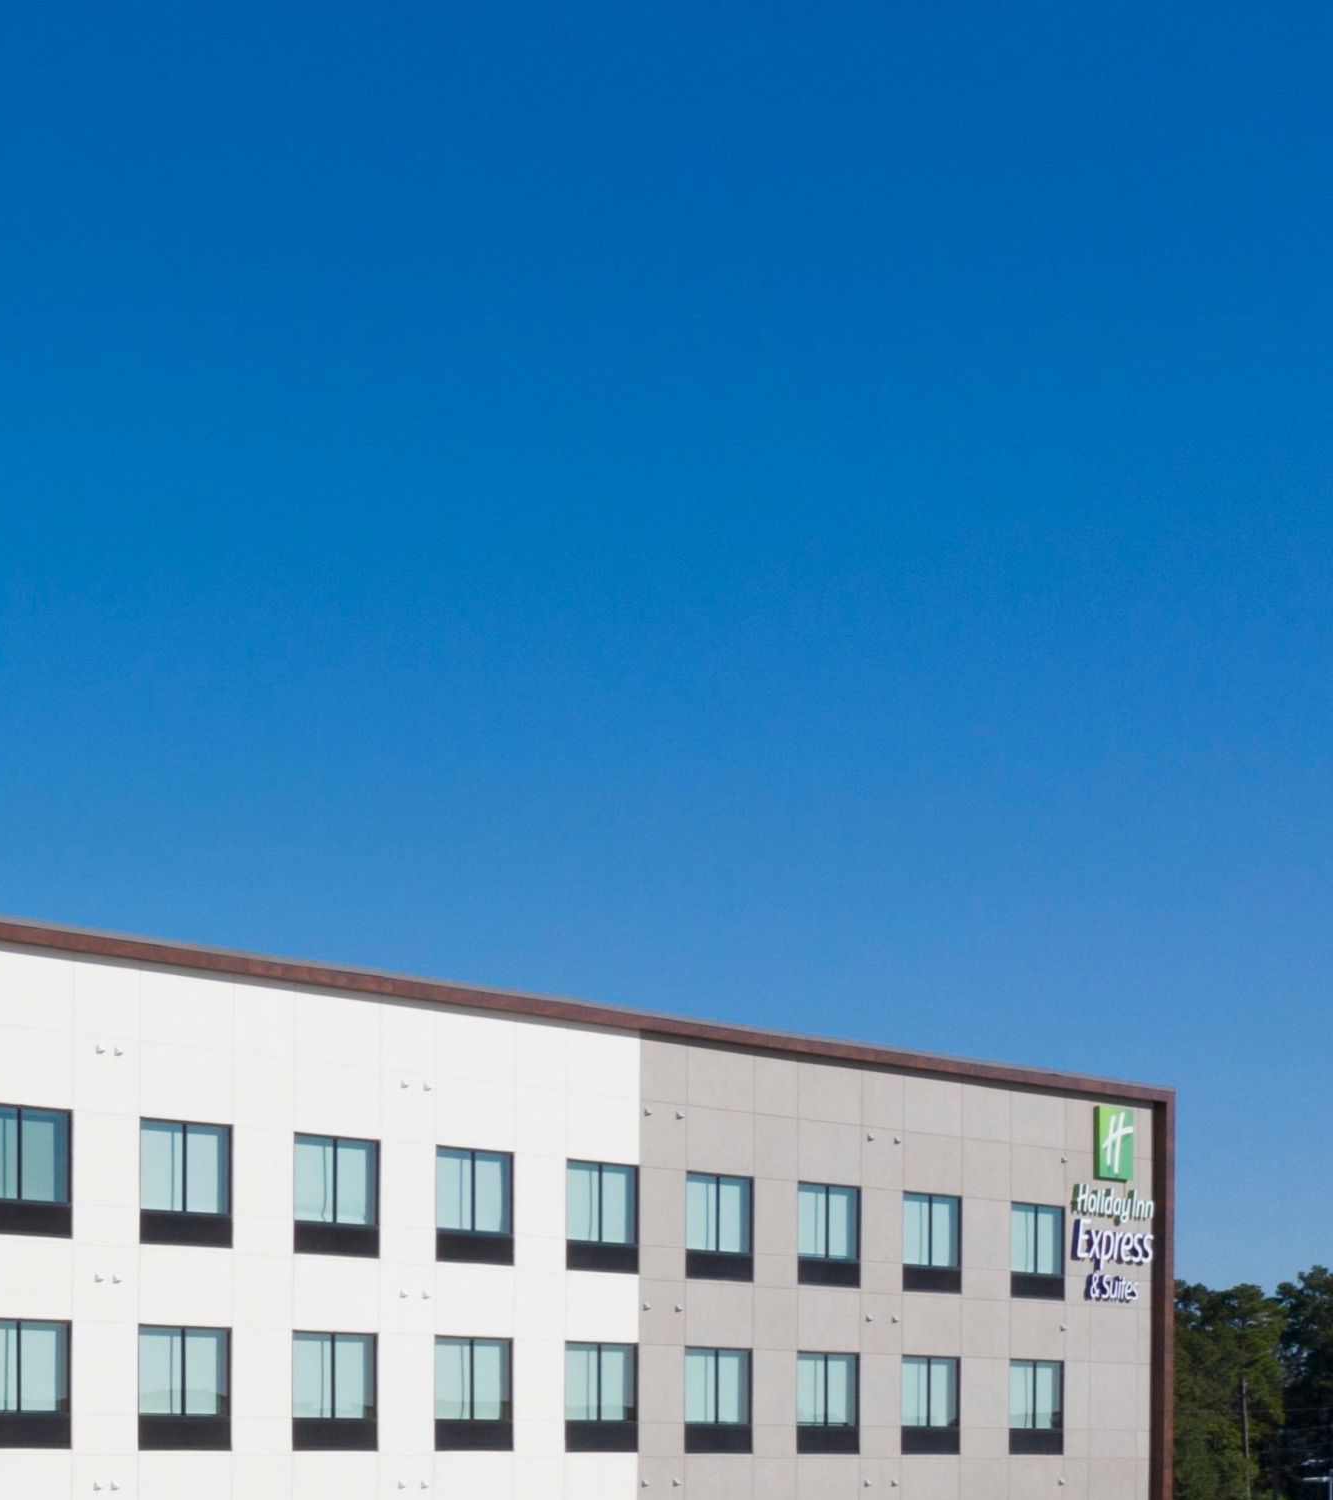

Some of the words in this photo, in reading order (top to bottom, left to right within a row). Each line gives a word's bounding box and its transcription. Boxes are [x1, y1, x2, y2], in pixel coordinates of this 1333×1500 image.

[1102, 1111, 1133, 1174] H
[1075, 1183, 1130, 1222] Holiday
[1131, 1193, 1154, 1219] Inn
[1075, 1218, 1153, 1270] Express
[1089, 1269, 1100, 1298] &
[1101, 1273, 1140, 1301] Suites
